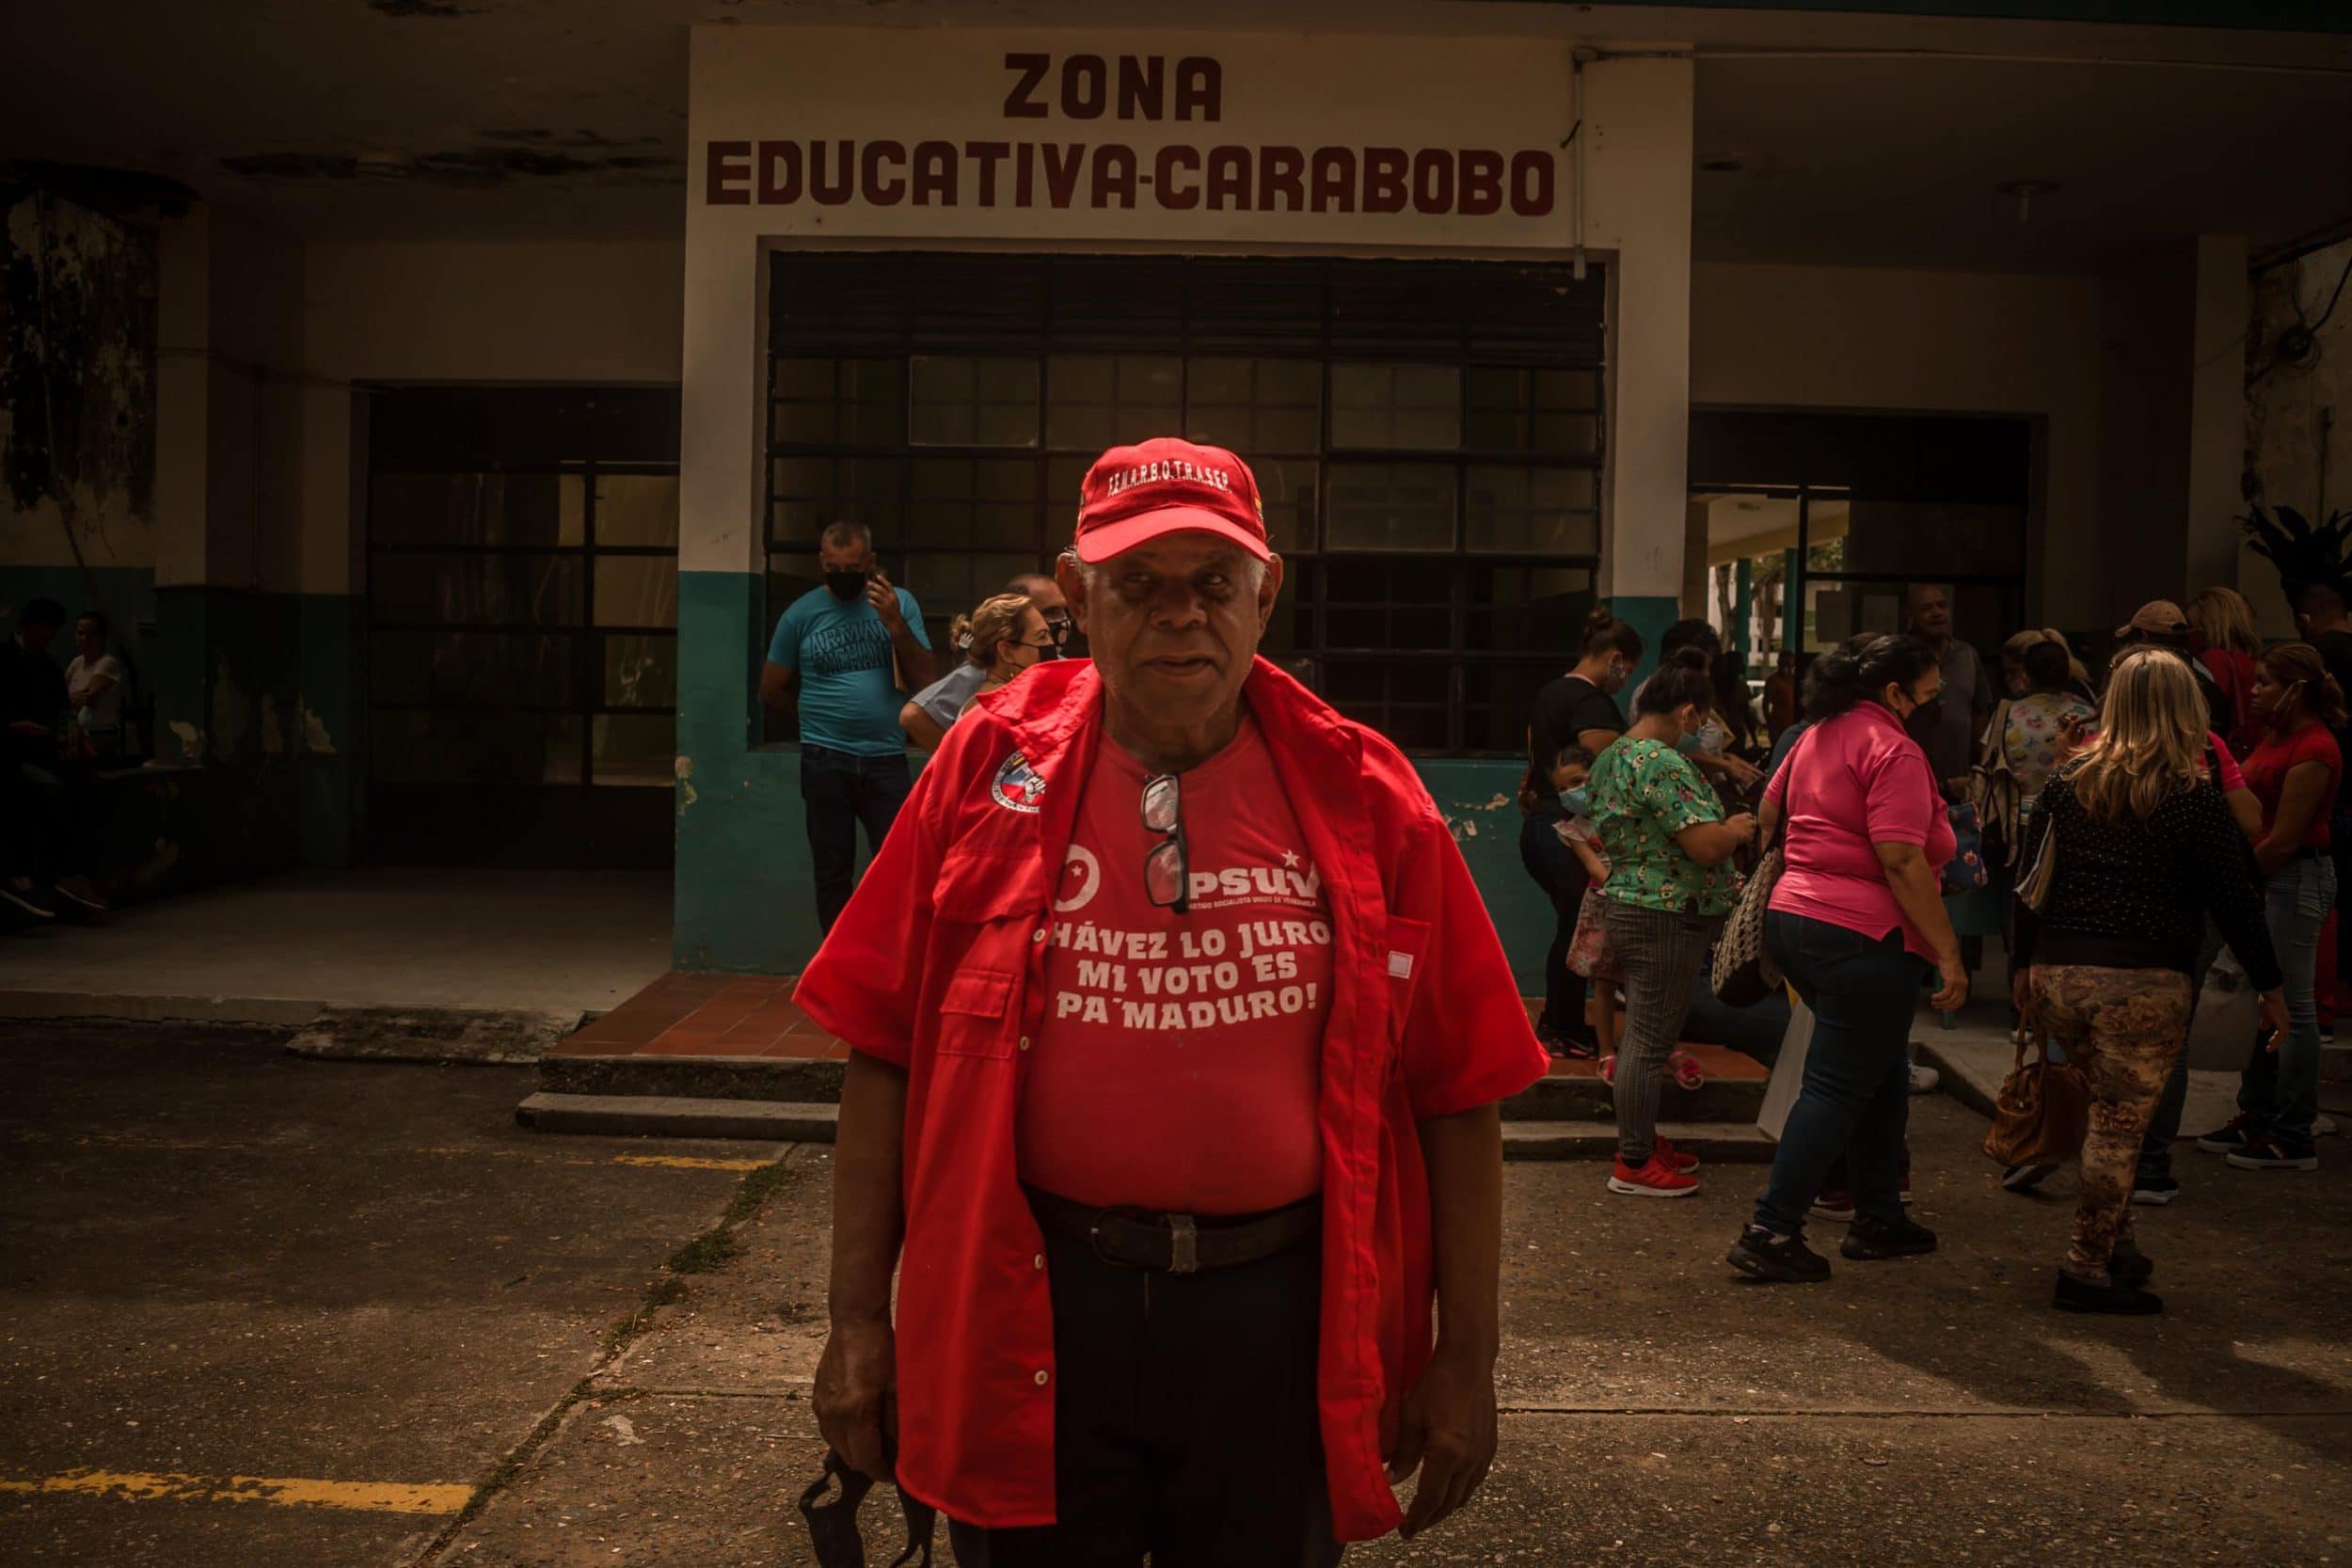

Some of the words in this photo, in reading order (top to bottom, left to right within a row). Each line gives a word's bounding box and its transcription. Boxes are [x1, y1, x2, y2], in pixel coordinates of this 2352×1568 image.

[1003, 54, 1223, 122] ZONA
[706, 139, 1556, 218] EDUCATIVA-CARABOBO
[811, 619, 891, 657] ARMAN
[1187, 860, 1321, 899] PSUV
[1046, 920, 1168, 959] HÁVEZ
[1180, 928, 1226, 958] LO
[1237, 920, 1331, 959] JURO
[1076, 959, 1128, 992] MI
[1137, 960, 1239, 995] VOTO
[1251, 951, 1298, 983] ES
